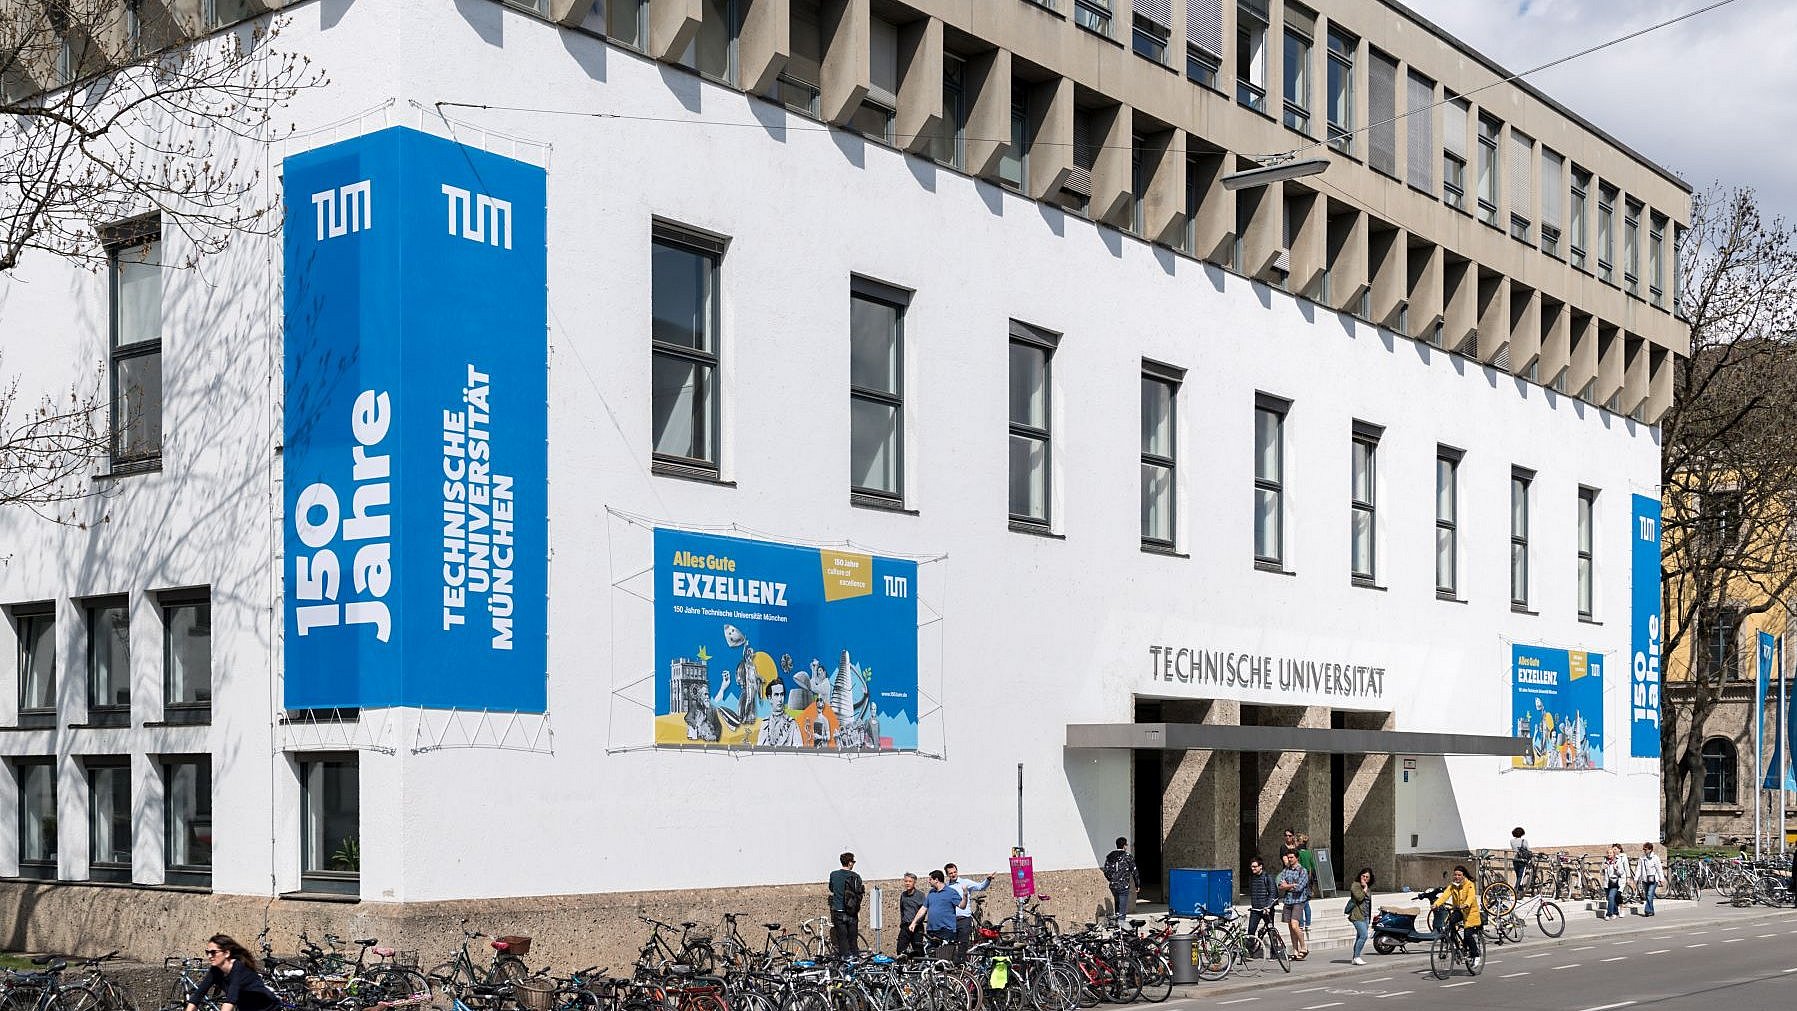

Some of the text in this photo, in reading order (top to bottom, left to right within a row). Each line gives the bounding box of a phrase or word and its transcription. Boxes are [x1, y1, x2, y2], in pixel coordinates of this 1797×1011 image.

[312, 180, 372, 240] TUM
[442, 184, 512, 249] TUM
[463, 364, 491, 593] UNIVERSITÄT
[343, 389, 392, 643] Jahre
[443, 409, 466, 631] TECHNISCHE
[295, 483, 340, 637] 150
[486, 475, 514, 650] MÜNCHEN
[673, 551, 736, 573] Alles Gute
[673, 571, 788, 607] EXZELLENZ
[883, 575, 907, 598] TUM
[673, 605, 788, 623] 150 Jahre Technische Universität München
[1150, 645, 1386, 699] TECHNISCHE UNIVERSITÄT
[1518, 668, 1558, 686] EXZELLENZ
[1633, 651, 1647, 723] 150
[1646, 614, 1659, 730] Jahre
